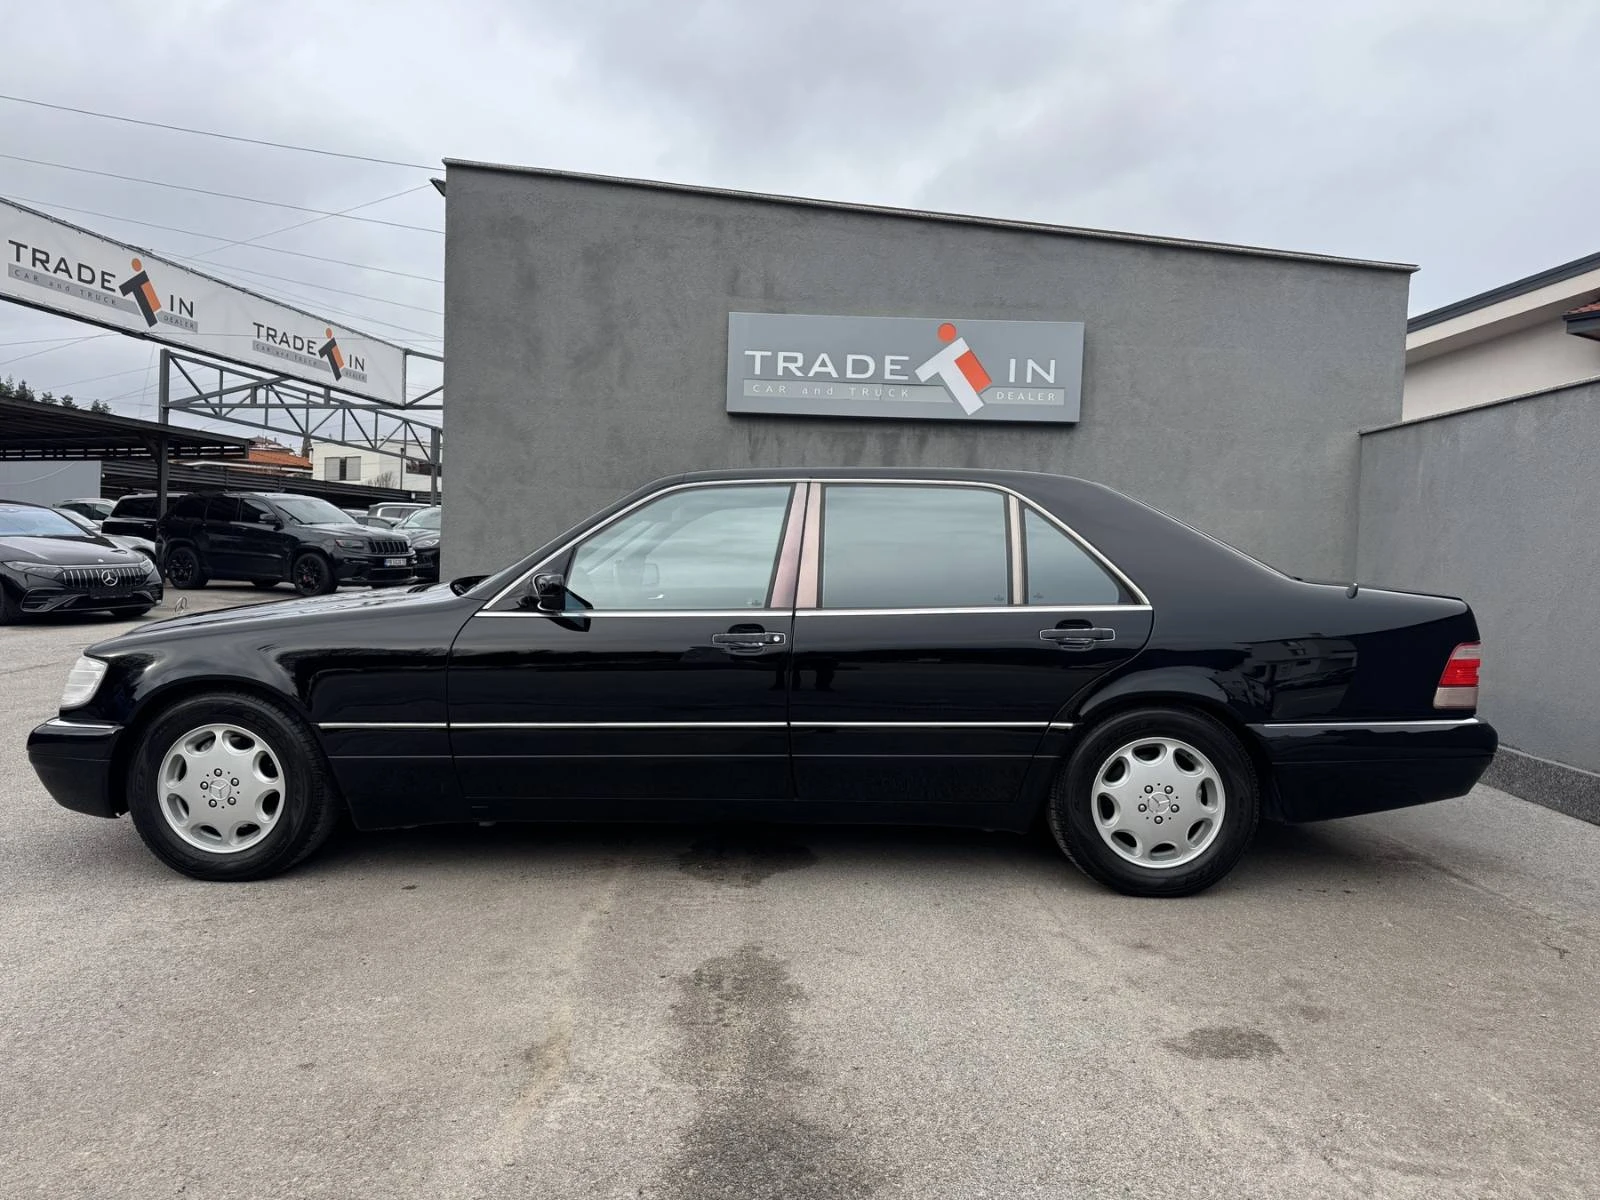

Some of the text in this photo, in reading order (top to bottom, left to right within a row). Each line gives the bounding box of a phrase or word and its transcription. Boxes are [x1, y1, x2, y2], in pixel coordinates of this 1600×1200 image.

[8, 239, 116, 292] TRADE
[169, 294, 194, 318] IN
[252, 322, 317, 355] TRADE
[349, 354, 365, 372] IN
[744, 350, 910, 381] TRADE
[1008, 358, 1056, 384] IN
[752, 384, 1056, 401] CAR and TRUCK DEALER
